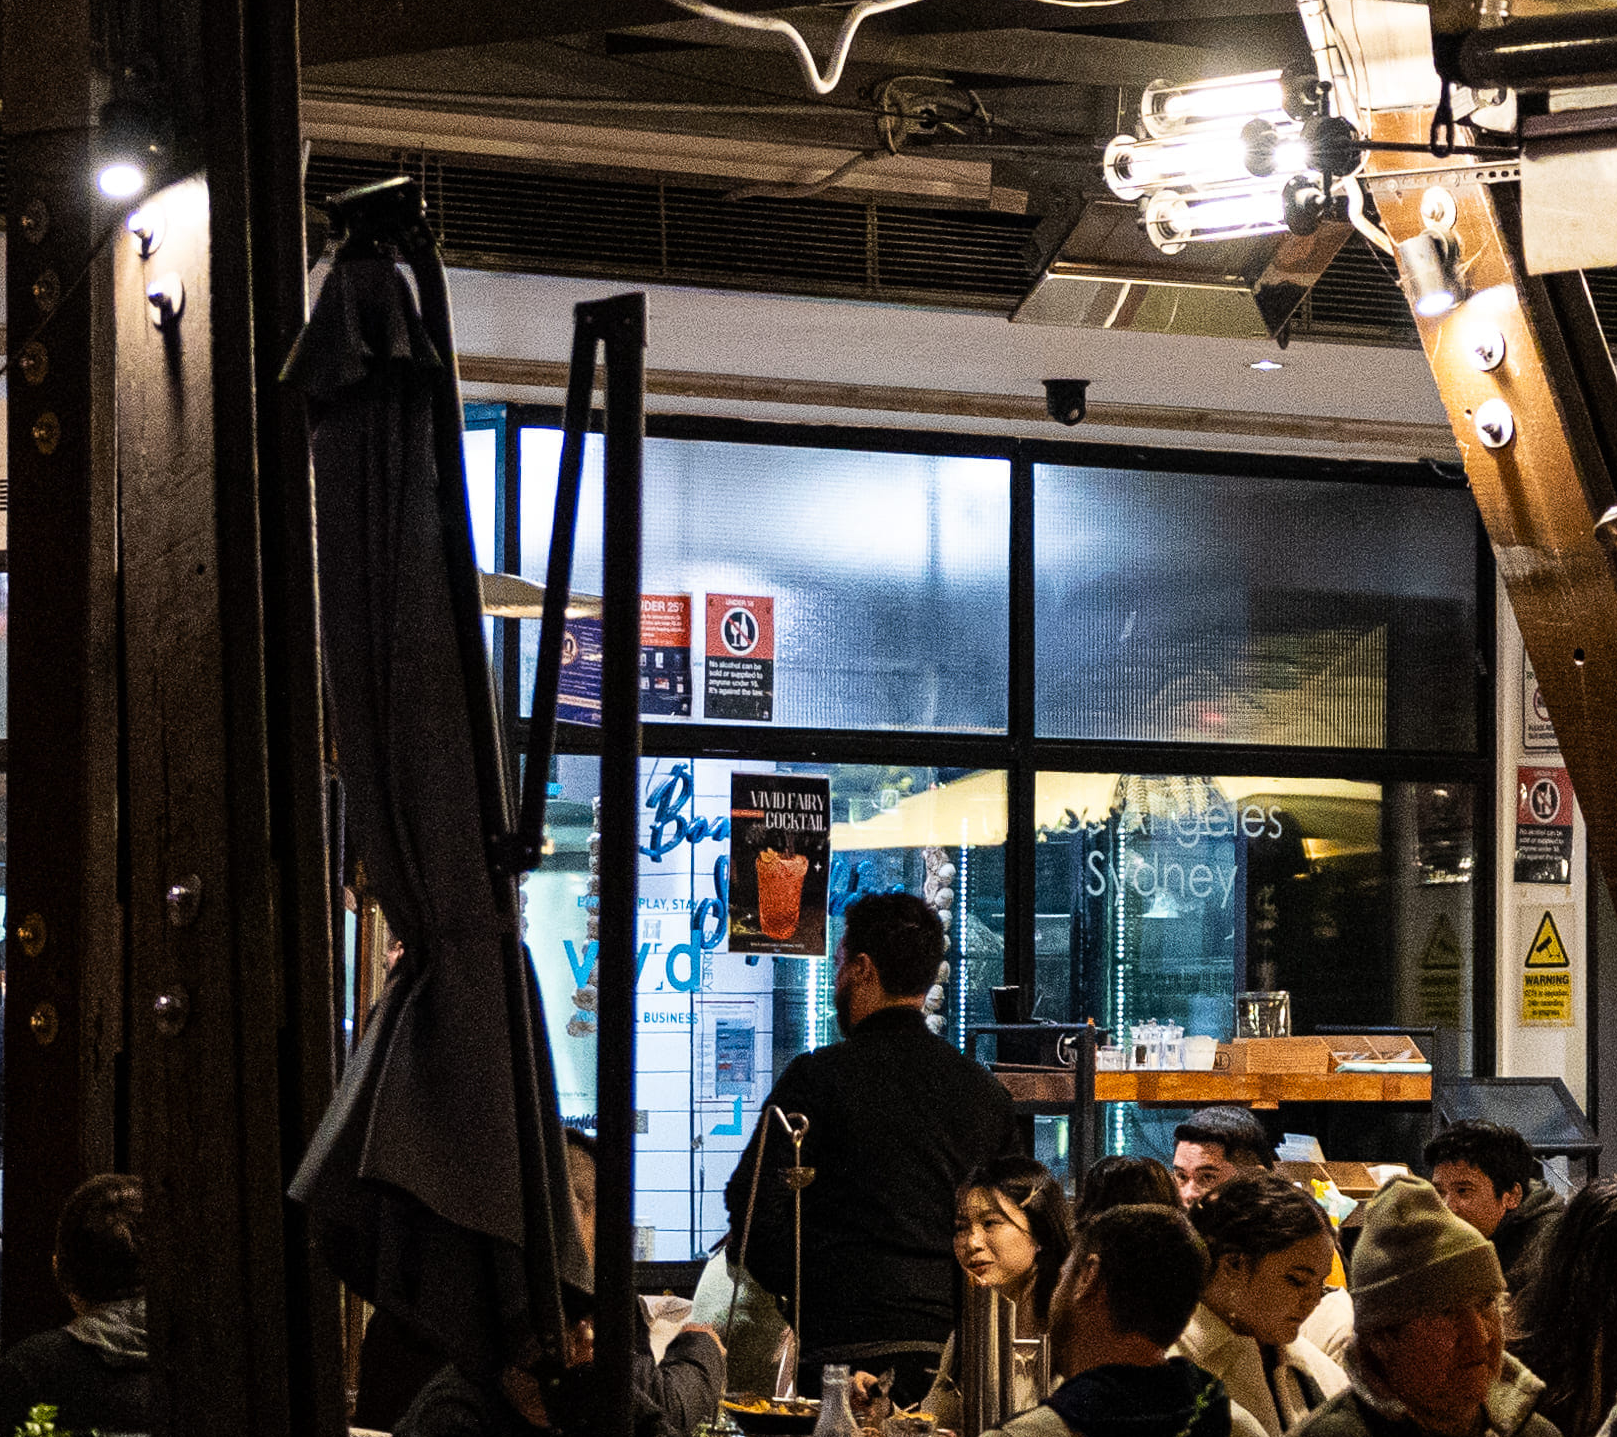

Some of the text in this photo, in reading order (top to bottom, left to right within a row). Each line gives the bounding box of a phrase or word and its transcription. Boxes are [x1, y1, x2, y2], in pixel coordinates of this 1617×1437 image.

[640, 600, 666, 612] DER
[750, 790, 826, 812] VIVID FAIRY
[765, 811, 828, 832] COCKTAIL
[1119, 796, 1284, 848] Angeles
[1086, 849, 1238, 908] Sydney
[638, 897, 669, 911] PLAY,
[703, 930, 714, 991] SDNEY
[1525, 974, 1569, 985] WARNING
[644, 1011, 699, 1025] BUSINESS
